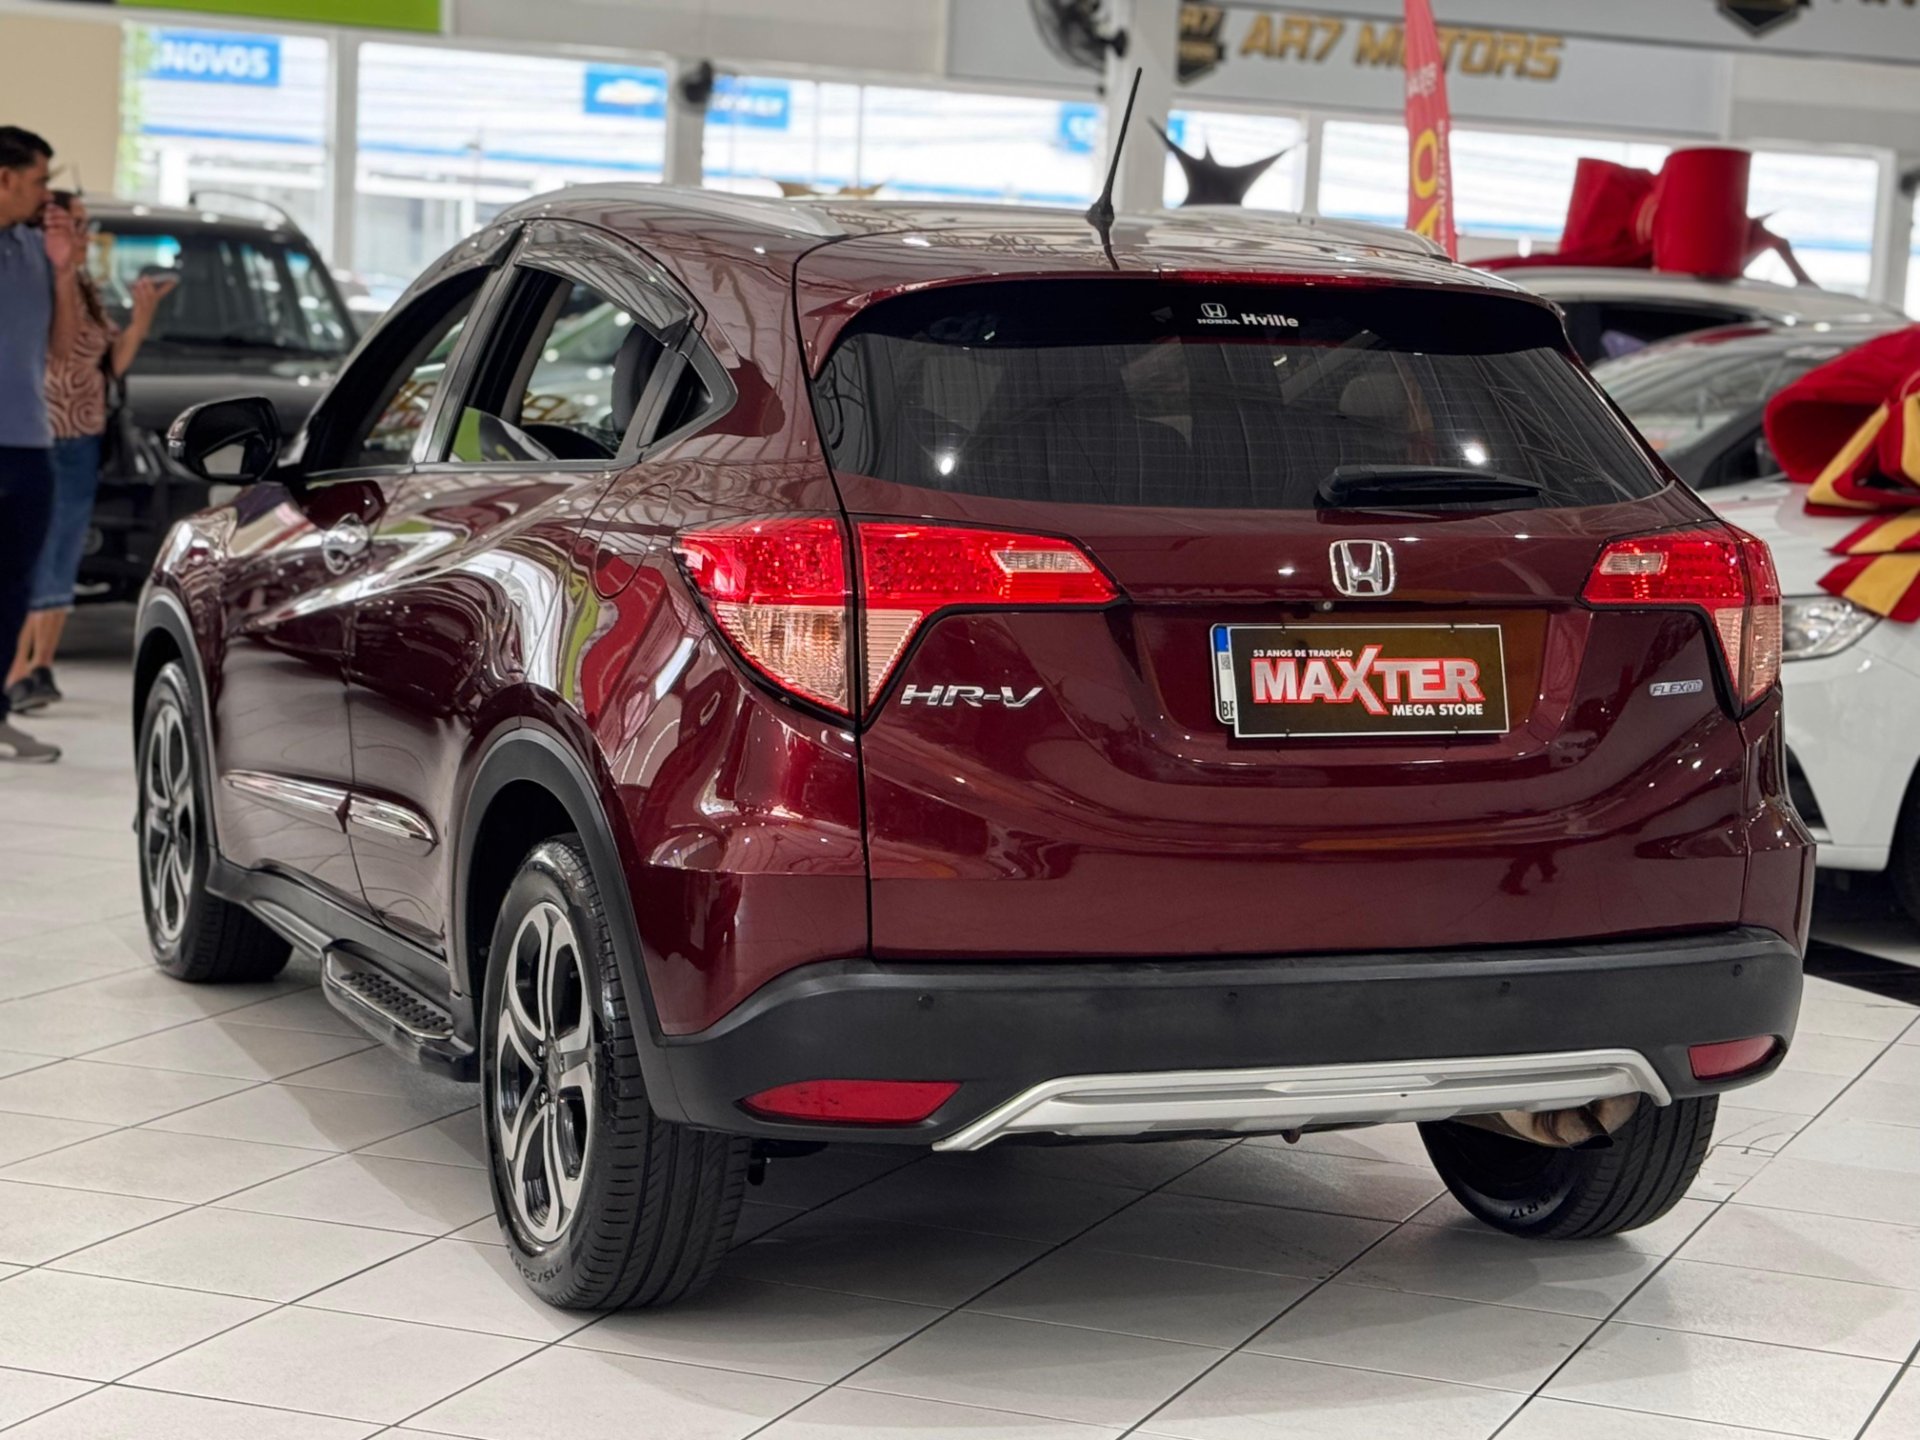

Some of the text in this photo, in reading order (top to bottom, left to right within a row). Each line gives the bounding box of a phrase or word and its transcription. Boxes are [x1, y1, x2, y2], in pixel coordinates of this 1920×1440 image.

[1239, 13, 1344, 63] AR7
[1353, 24, 1563, 81] MTORS
[1241, 313, 1299, 327] Hville
[1308, 648, 1353, 659] TRADIÇÃO
[1251, 645, 1486, 715] MAXTER
[900, 684, 1043, 708] HR-V
[1392, 704, 1483, 716] MEGA STORE
